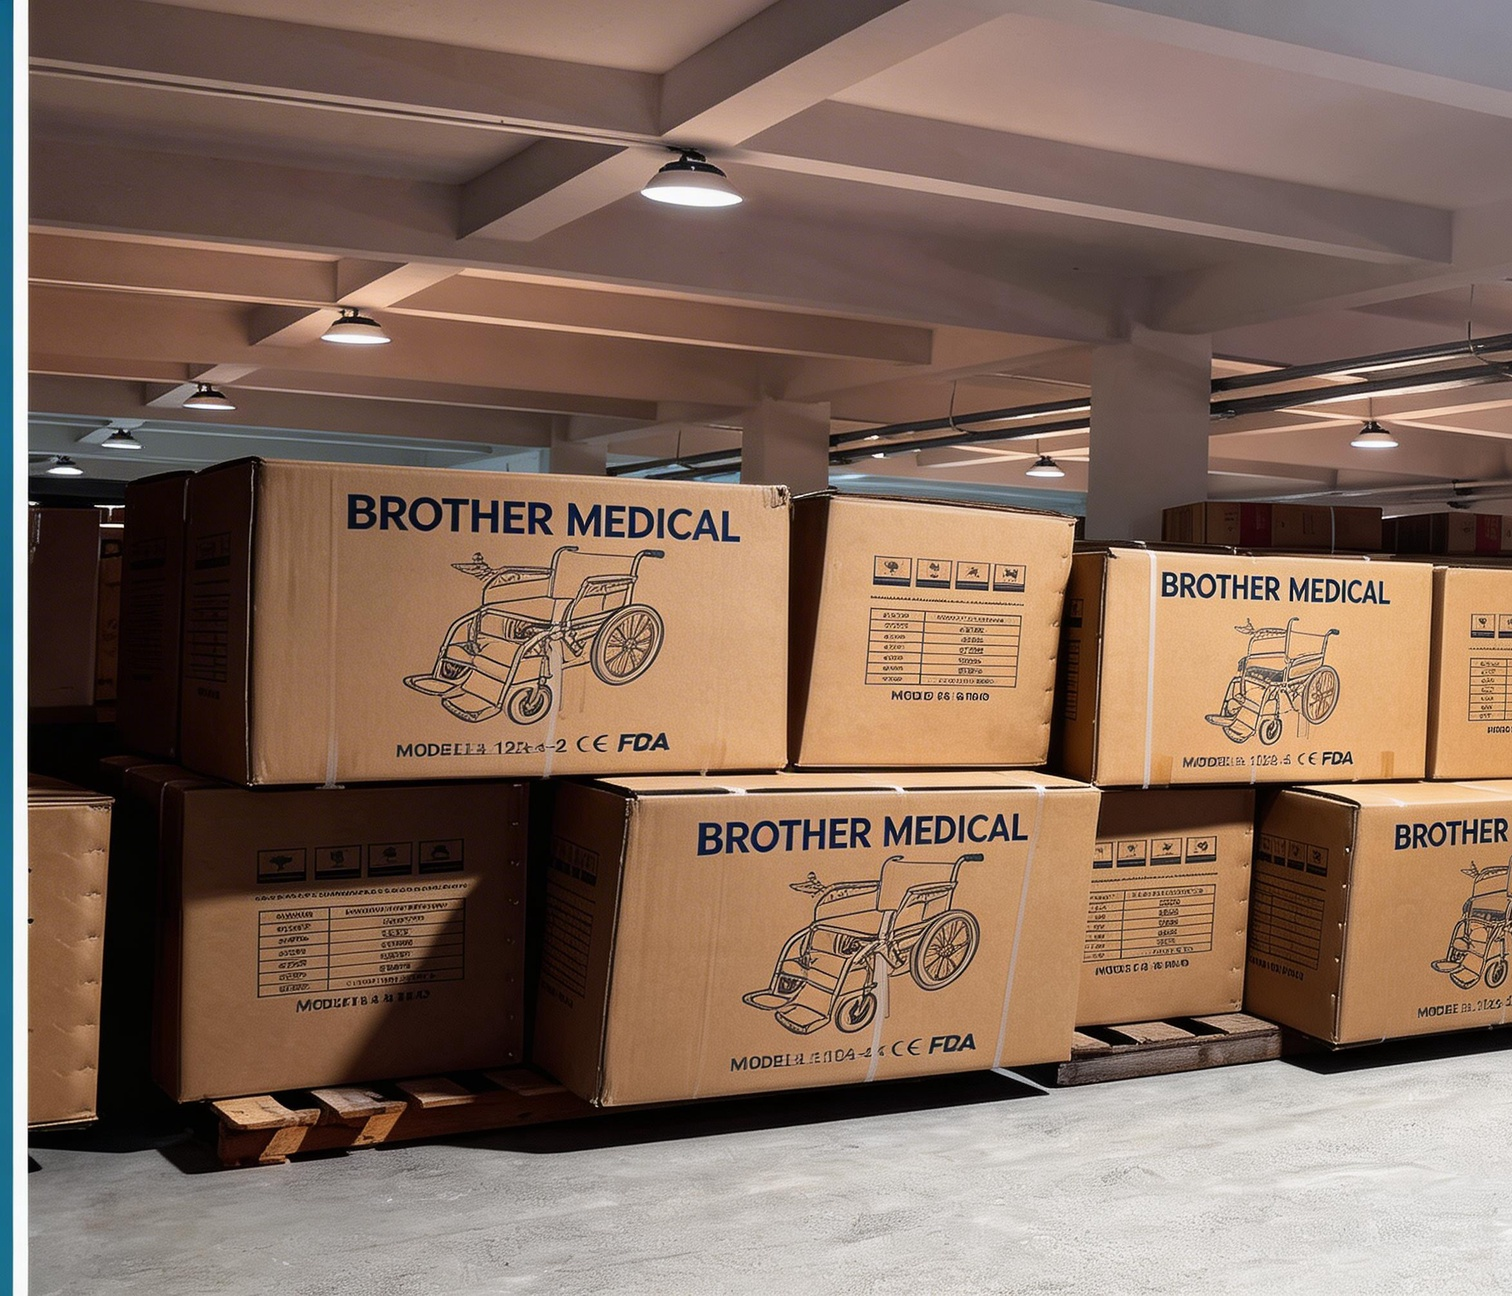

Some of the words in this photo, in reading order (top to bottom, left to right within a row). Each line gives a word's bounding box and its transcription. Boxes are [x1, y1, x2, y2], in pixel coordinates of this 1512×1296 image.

[346, 493, 554, 536] BROTHER
[567, 502, 741, 543] MEDICAL
[1161, 571, 1280, 601] BROTHER
[1289, 577, 1391, 605] MEDICAL
[1321, 750, 1354, 766] FDA
[697, 816, 872, 857] BROTHER
[883, 812, 1029, 848] MEDICAL
[1394, 817, 1509, 850] BROTHER
[928, 1033, 977, 1055] FDA
